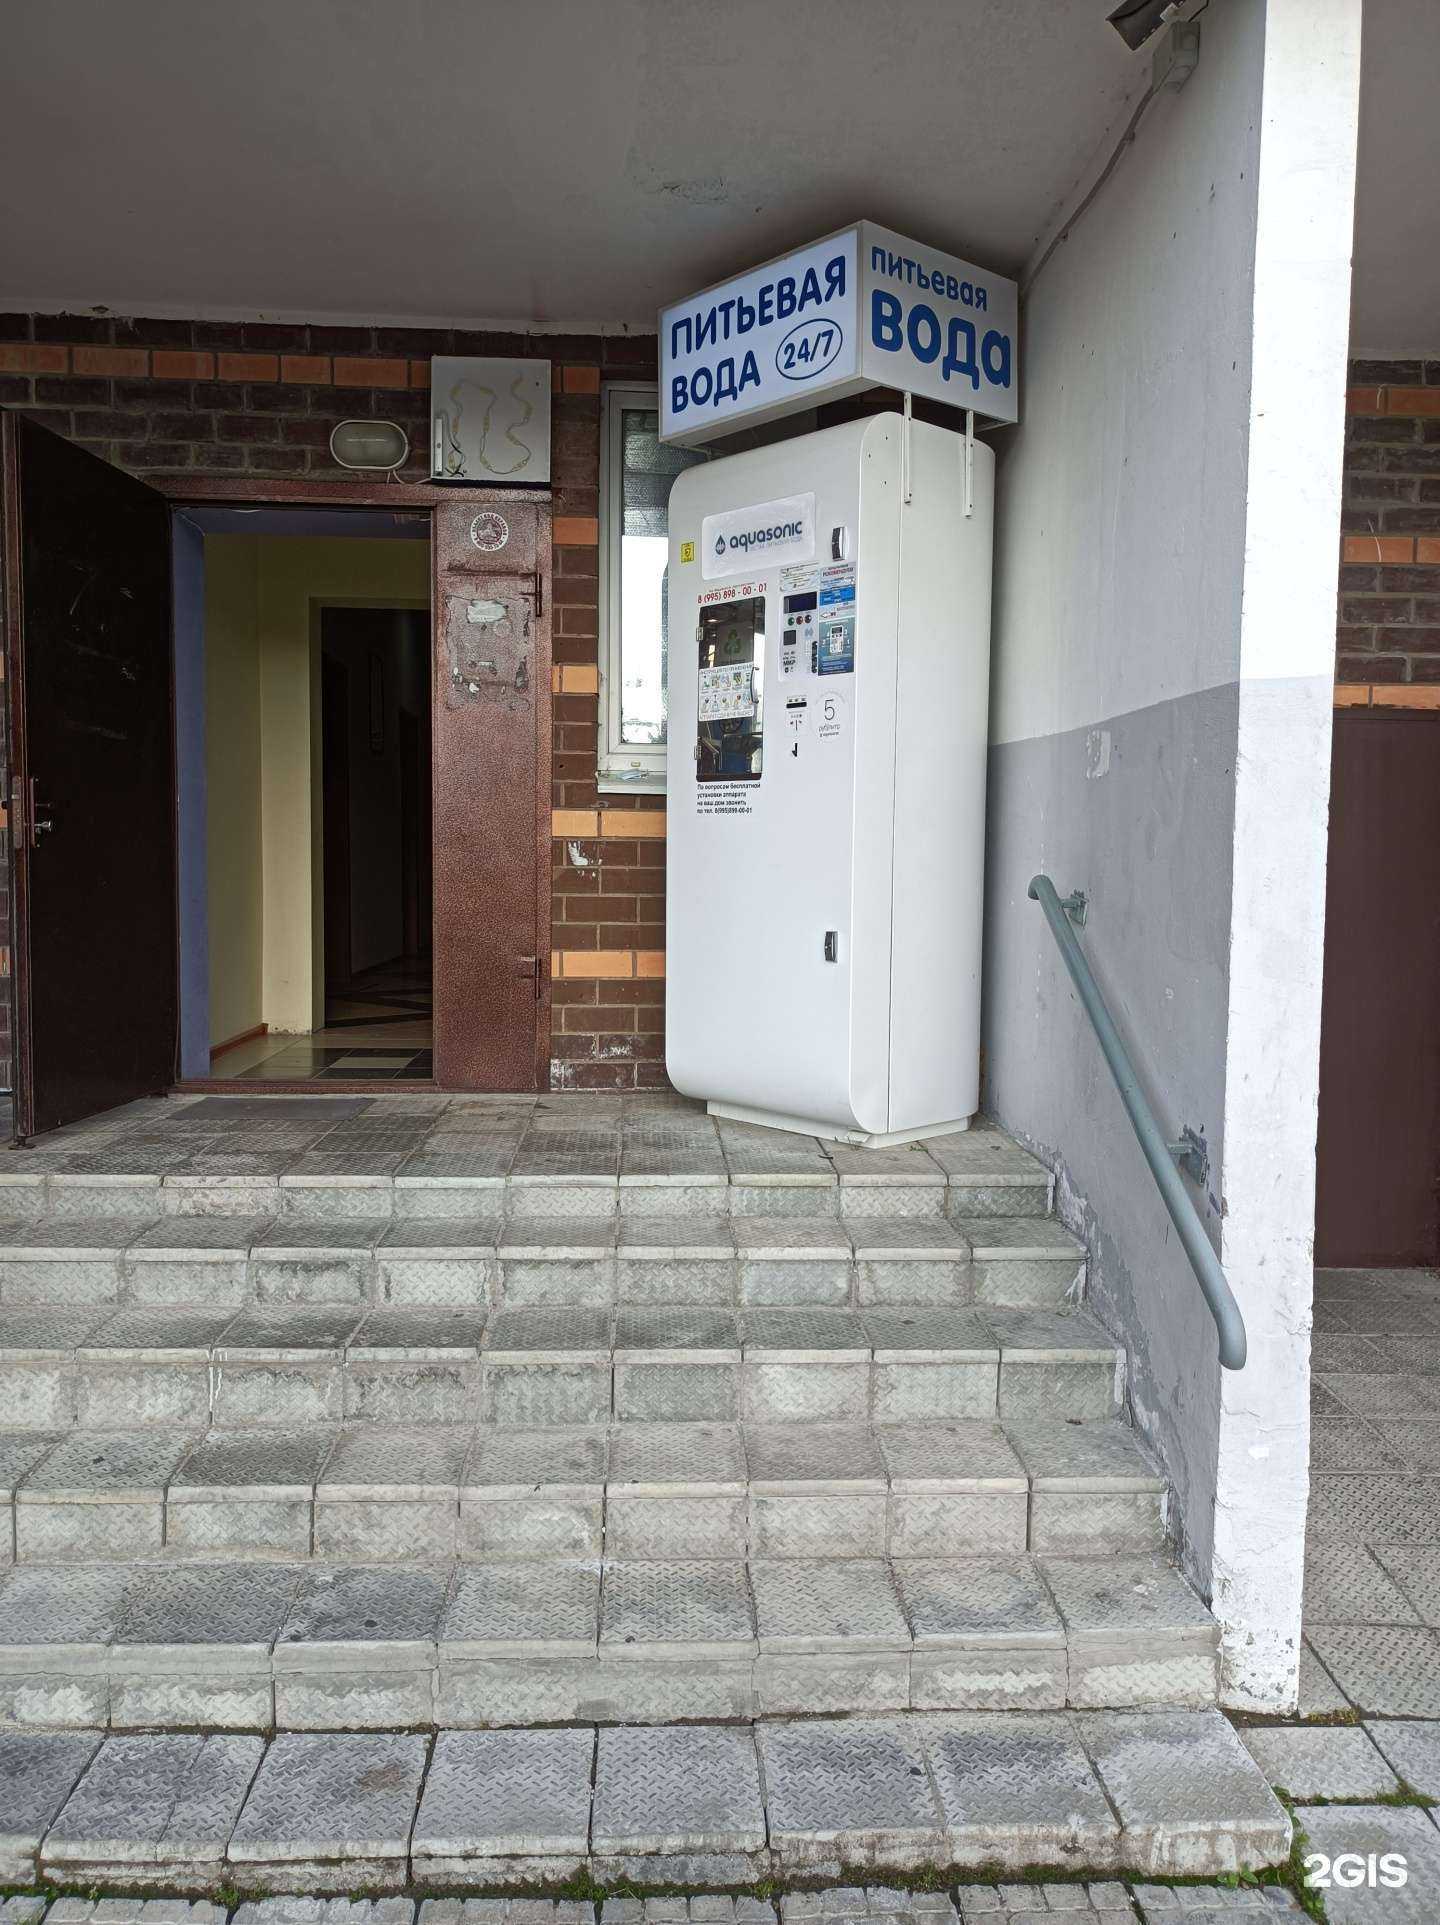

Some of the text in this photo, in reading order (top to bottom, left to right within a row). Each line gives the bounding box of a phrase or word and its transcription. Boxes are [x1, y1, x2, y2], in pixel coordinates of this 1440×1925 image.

[871, 245, 988, 312] питьевая
[671, 255, 846, 359] ПИТЬЕВАЯ
[783, 329, 834, 370] 24/7
[671, 349, 761, 415] ВОДА
[729, 520, 803, 552] aquasonic
[703, 591, 721, 604] (995)
[722, 589, 736, 600] 898
[742, 585, 752, 596] 00
[758, 583, 767, 593] 01
[824, 698, 835, 721] 5
[704, 783, 730, 791] вопросам
[730, 782, 761, 790] бесплатной
